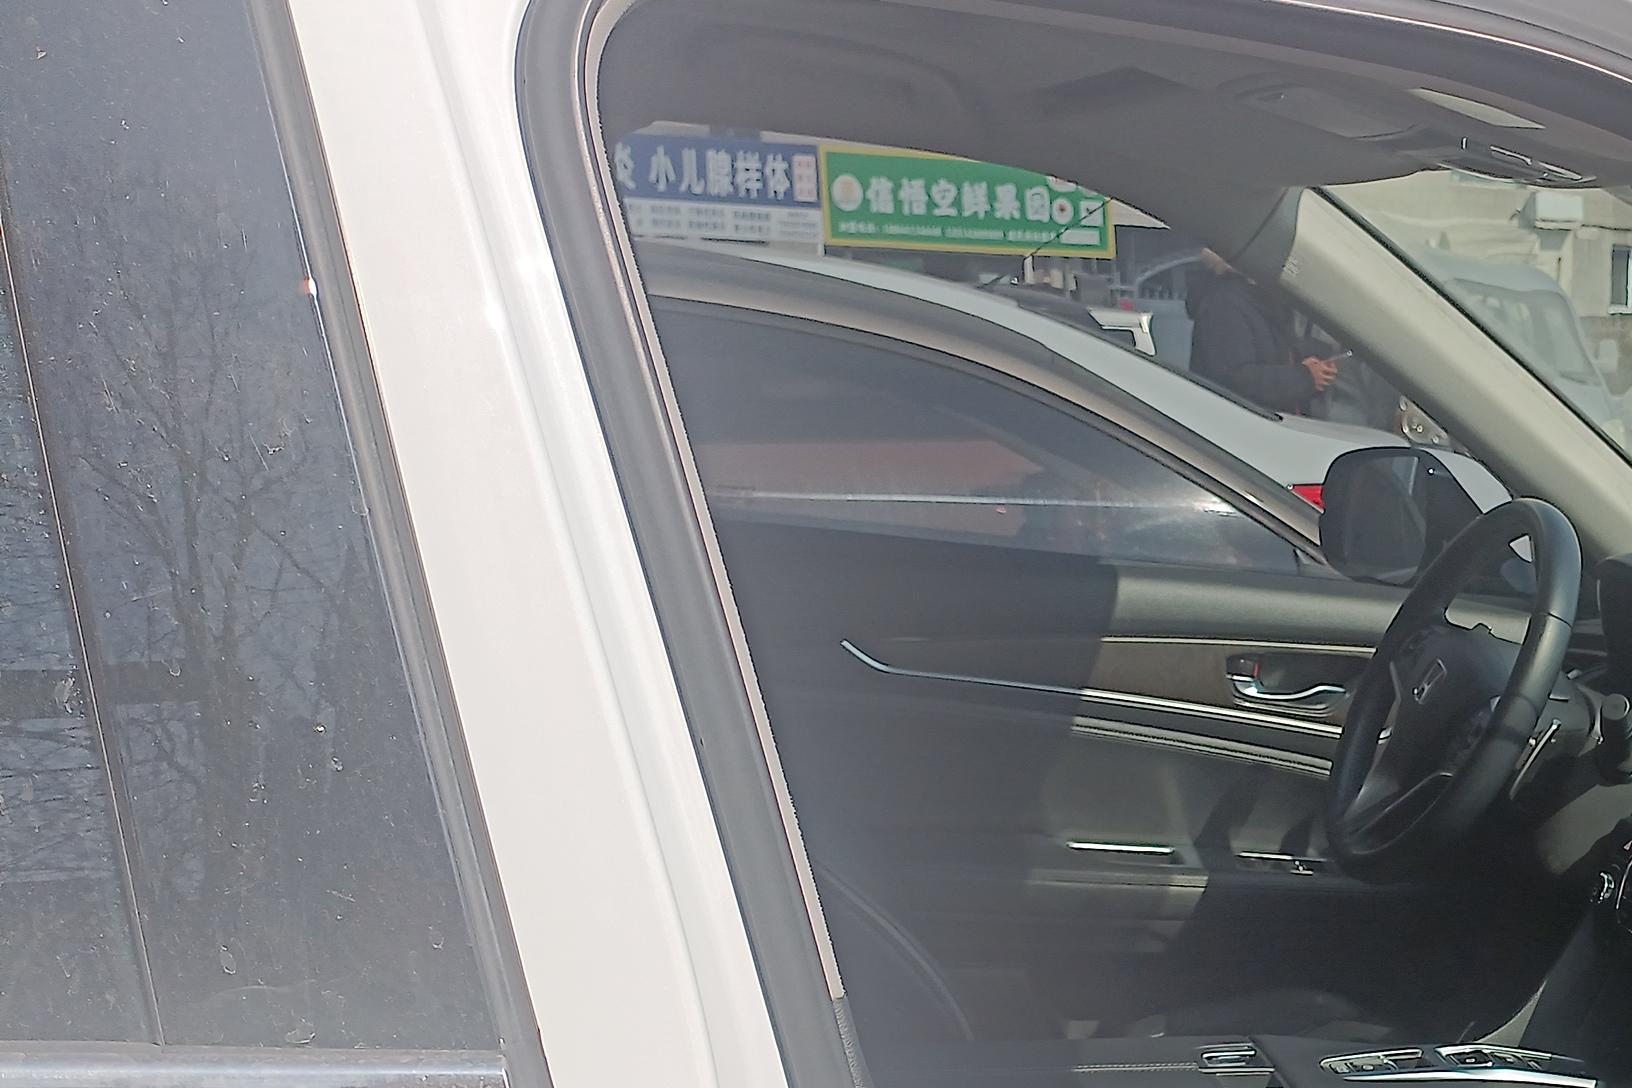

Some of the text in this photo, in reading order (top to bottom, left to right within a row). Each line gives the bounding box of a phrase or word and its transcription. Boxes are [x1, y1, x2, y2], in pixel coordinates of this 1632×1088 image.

[648, 145, 790, 200] 小儿腺样体
[865, 175, 1051, 224] 信悟空鲜果园
